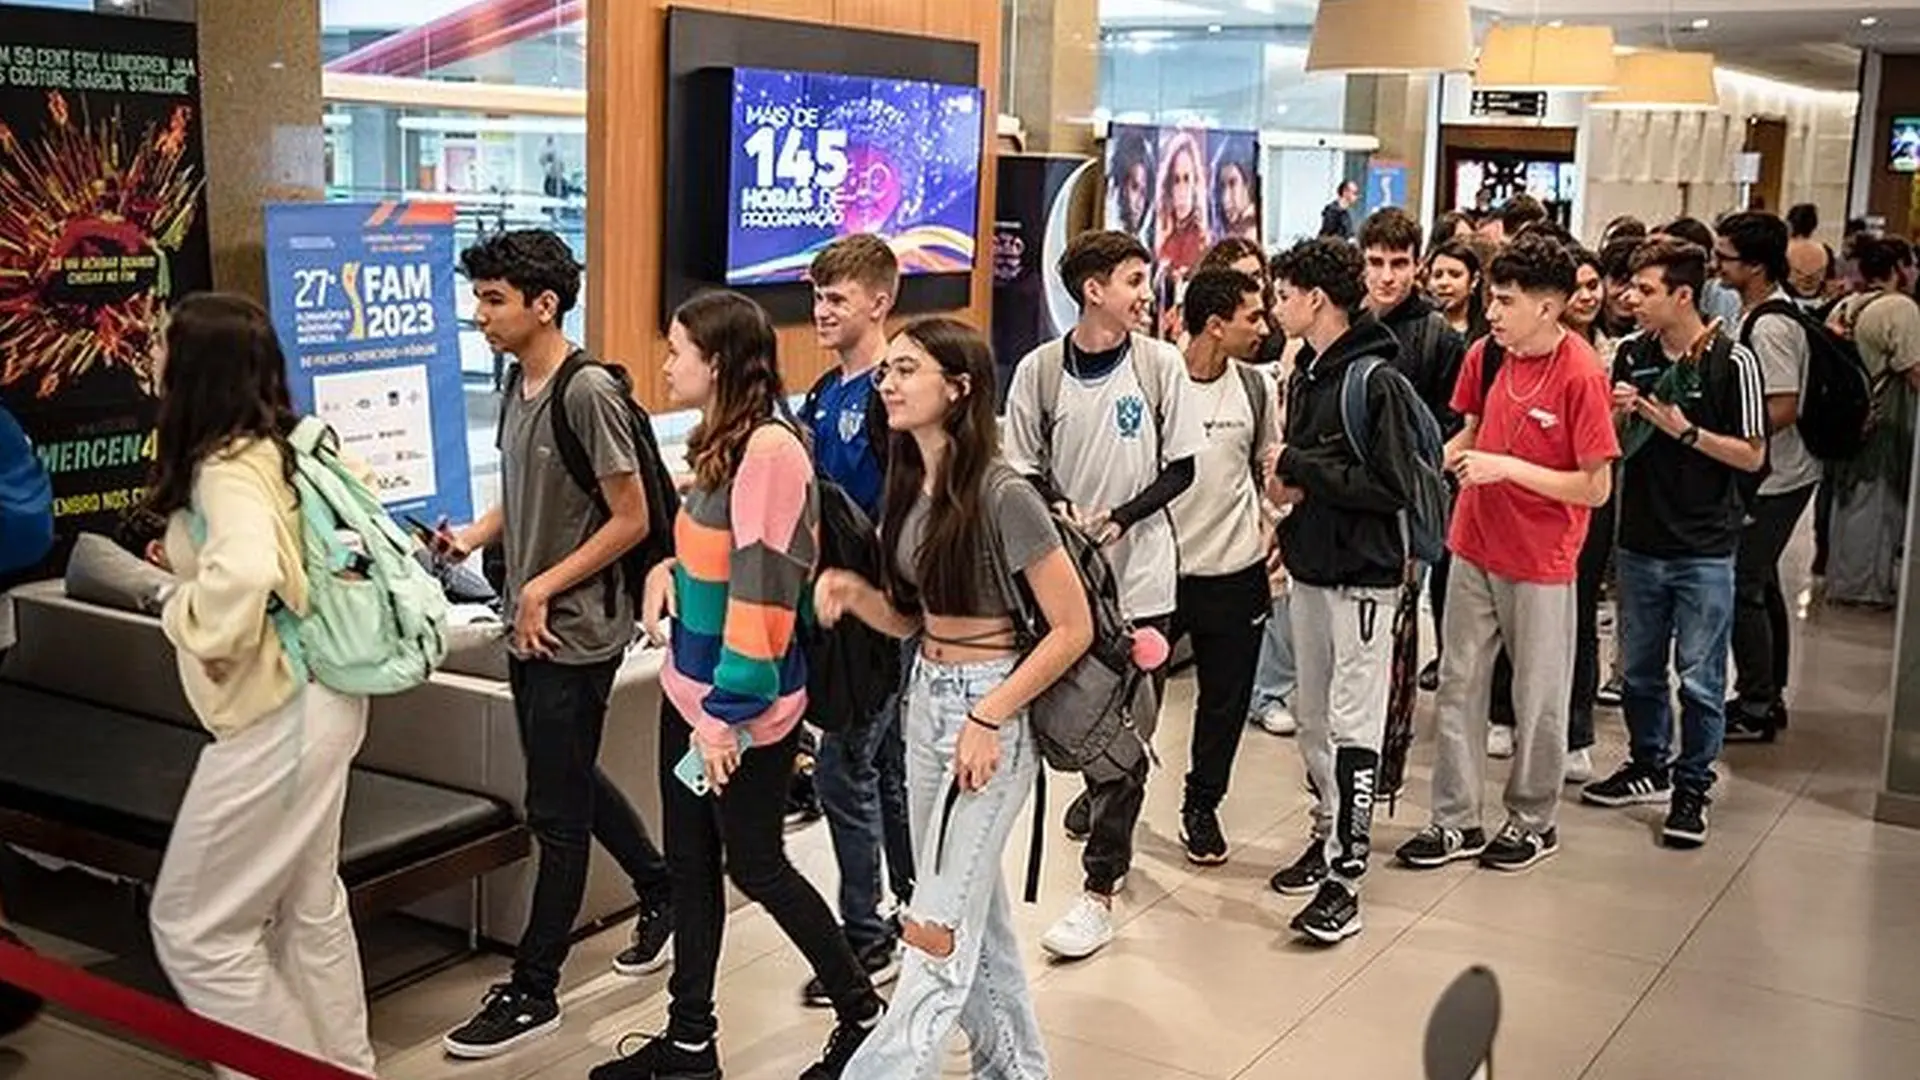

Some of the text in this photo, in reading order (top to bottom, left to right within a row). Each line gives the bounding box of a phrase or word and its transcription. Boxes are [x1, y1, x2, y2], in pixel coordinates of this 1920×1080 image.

[37, 49, 71, 69] CENT
[73, 51, 100, 70] FOX
[102, 54, 169, 72] LUNDGREN
[9, 66, 72, 89] COUTURE
[75, 71, 124, 91] GARCIA
[127, 75, 189, 95] STALLONE
[746, 105, 819, 128] MAIS DE
[744, 126, 849, 188] 145
[741, 187, 846, 210] HORAS DE
[363, 262, 432, 303] FAM
[366, 302, 435, 339] 2023
[102, 488, 130, 510] NOS
